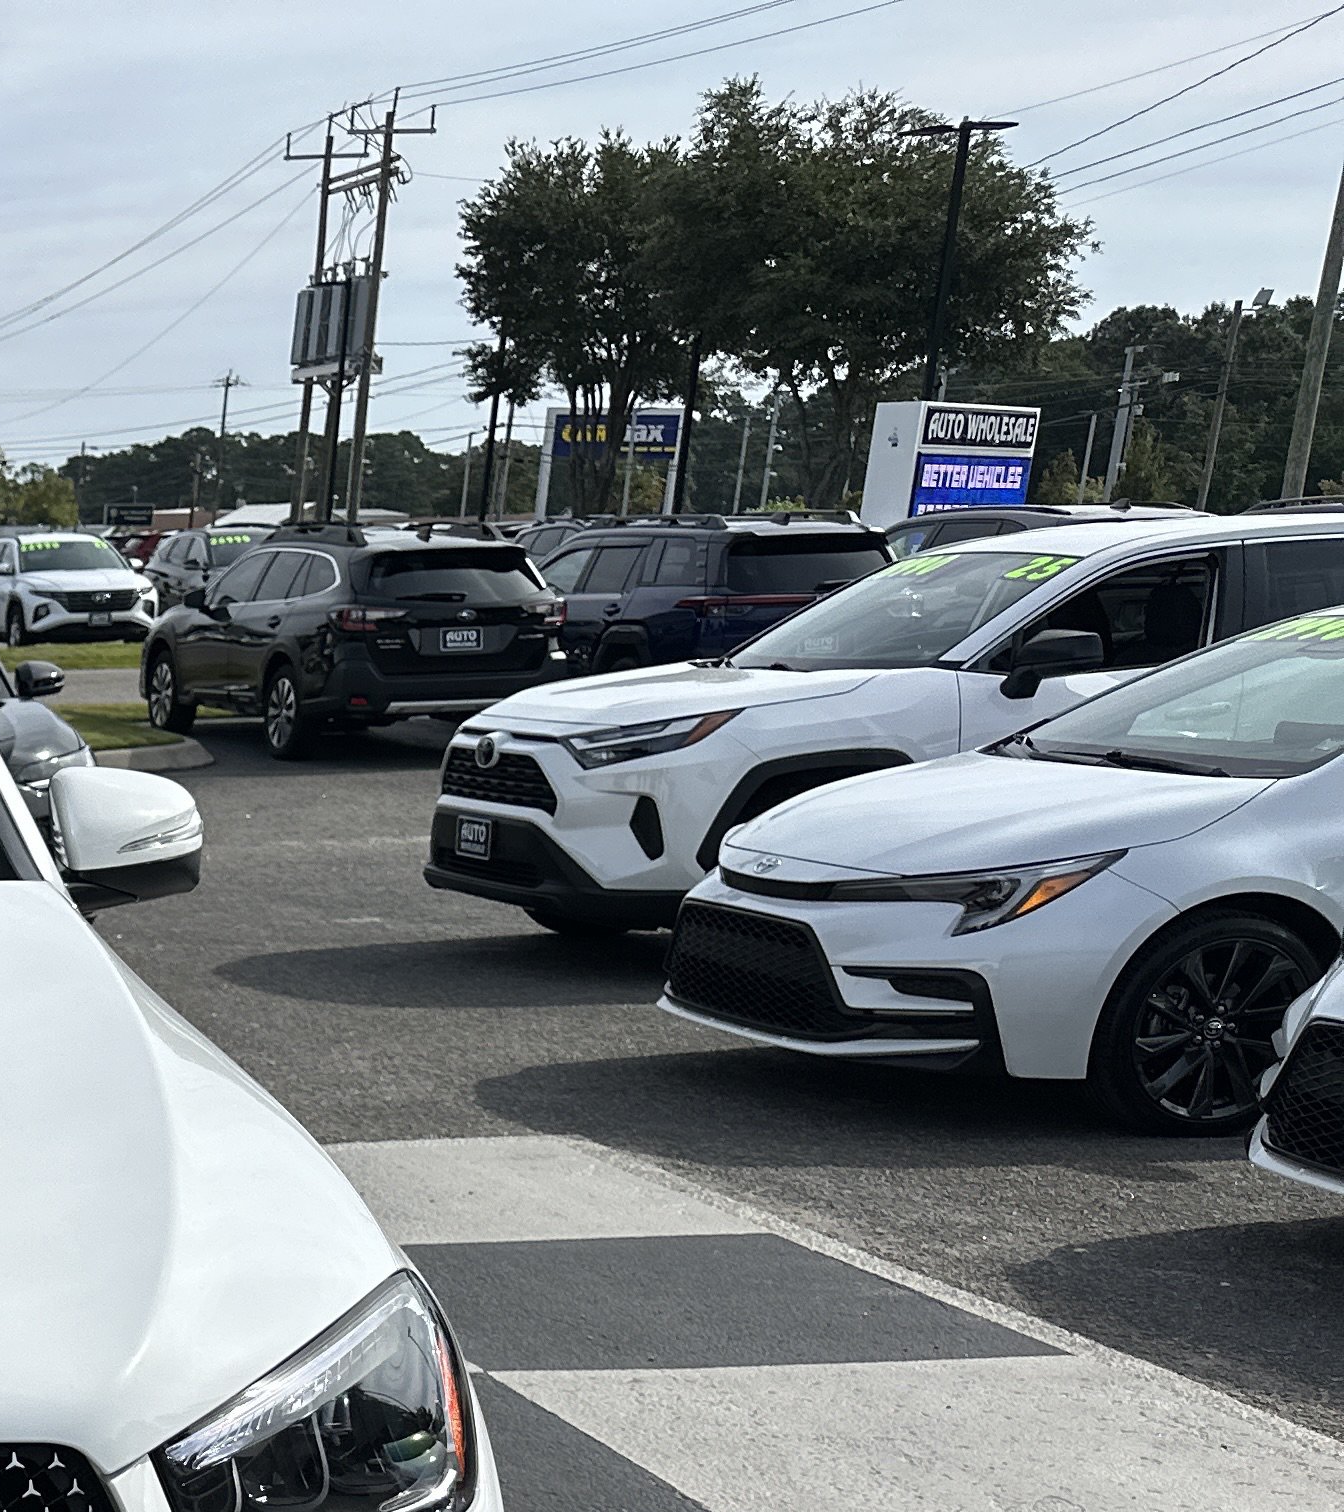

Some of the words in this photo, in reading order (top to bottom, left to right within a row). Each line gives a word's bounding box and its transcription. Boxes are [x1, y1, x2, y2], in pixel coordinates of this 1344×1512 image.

[928, 412, 964, 440] AUTO
[967, 414, 1035, 444] WHOLESALE
[921, 464, 968, 488] BETTER
[1003, 556, 1078, 581] 25
[445, 630, 477, 642] AUTO
[461, 822, 486, 843] AUTO
